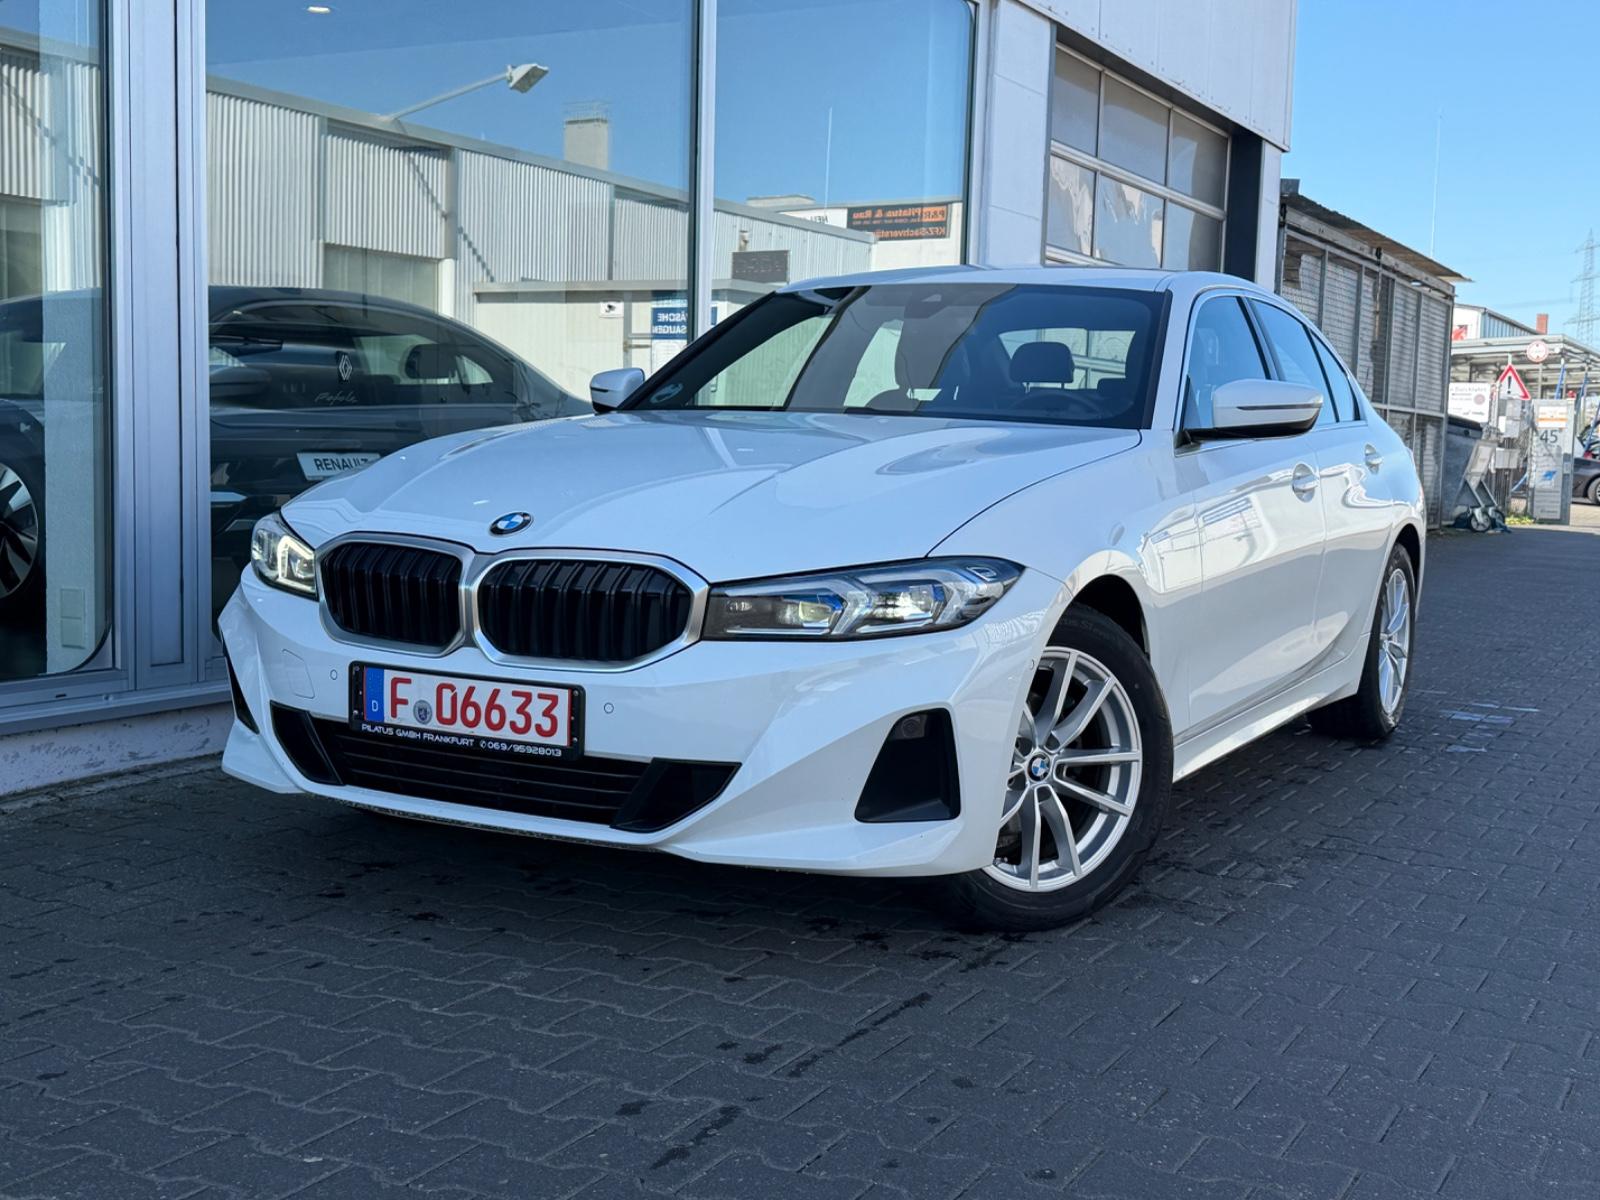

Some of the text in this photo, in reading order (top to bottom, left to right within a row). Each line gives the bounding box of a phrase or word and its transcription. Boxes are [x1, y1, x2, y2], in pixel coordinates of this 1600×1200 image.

[1540, 429, 1558, 443] 45
[371, 700, 379, 712] D
[390, 677, 559, 738] F 06633
[361, 723, 394, 736] PILATUS
[422, 732, 474, 747] FRANKFURT
